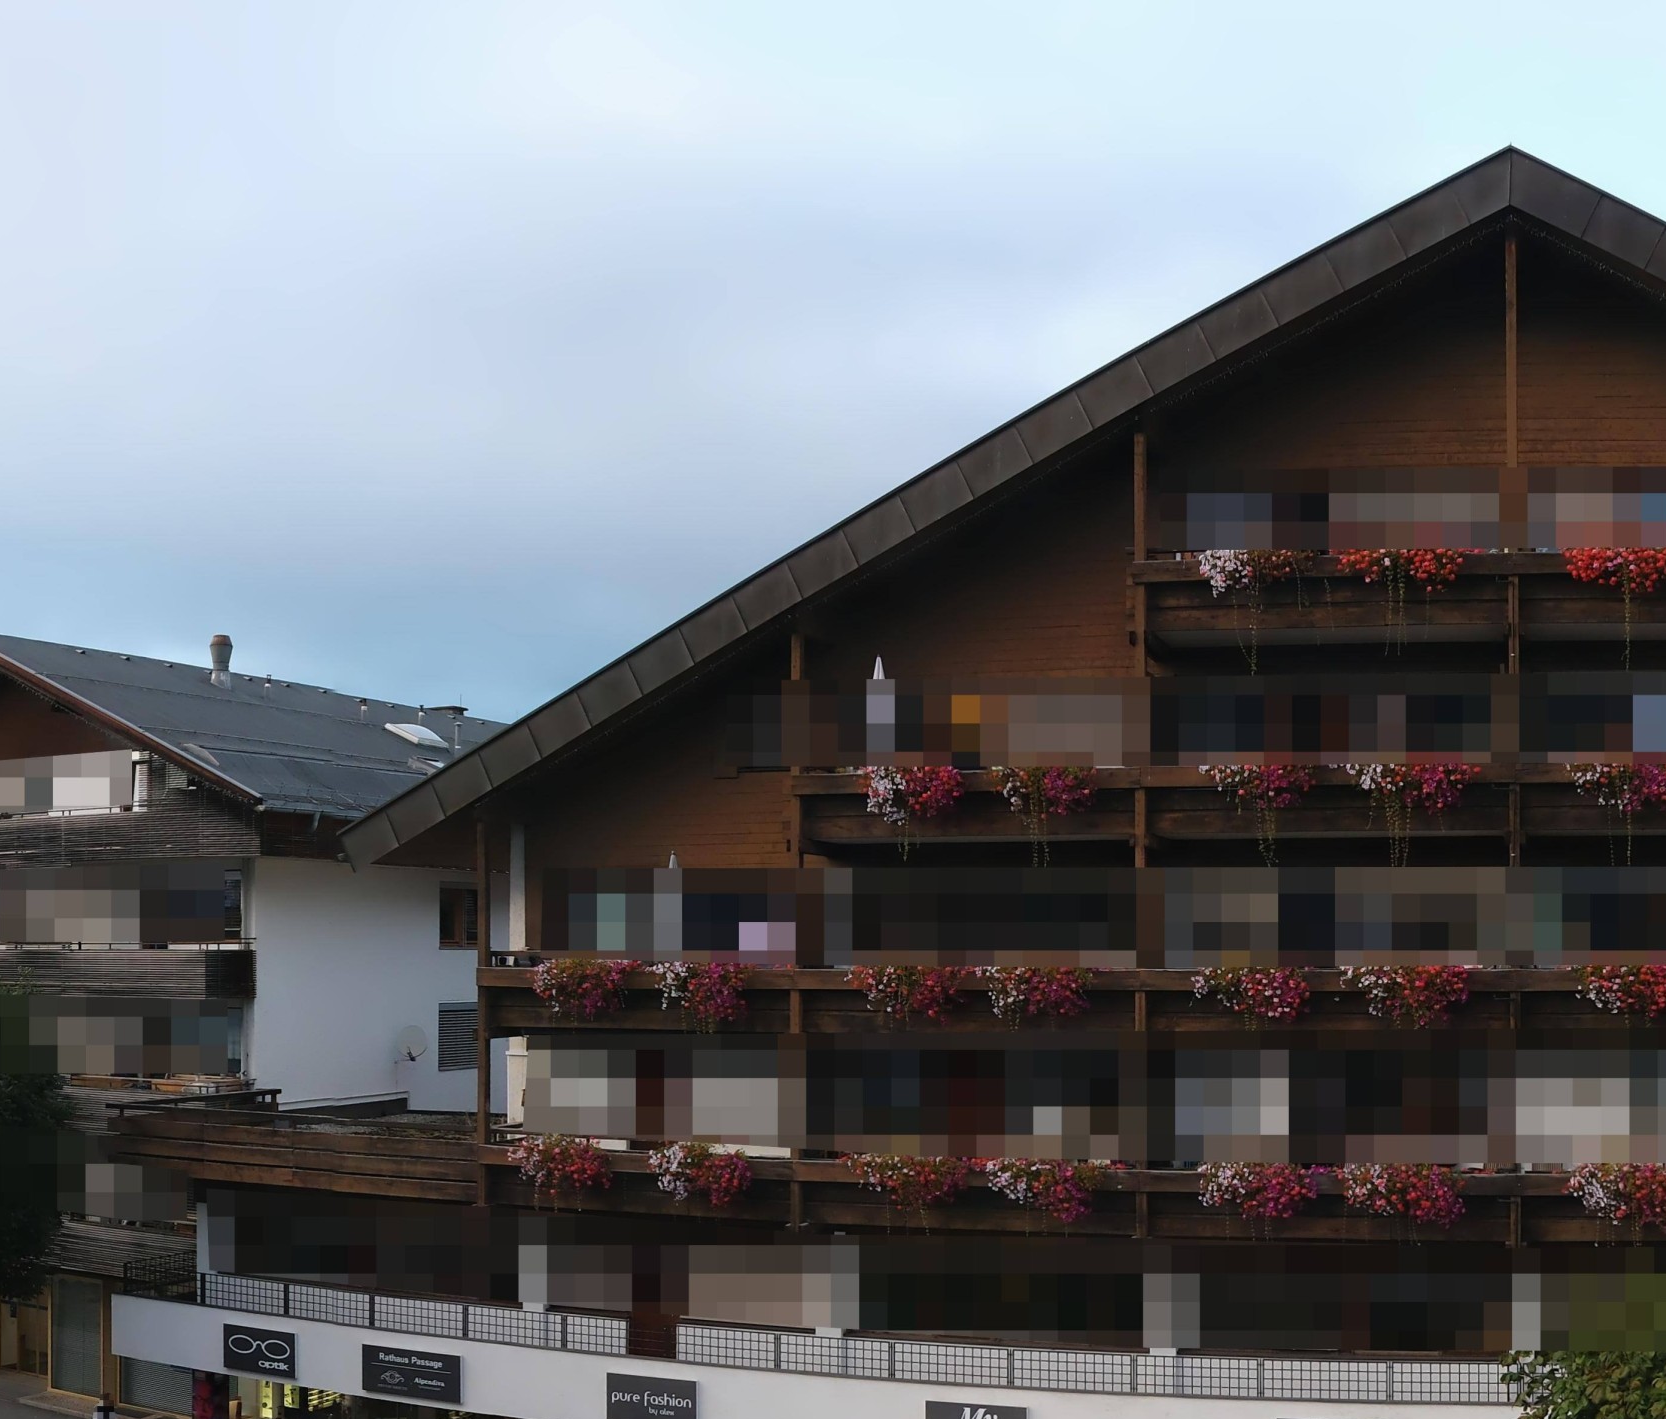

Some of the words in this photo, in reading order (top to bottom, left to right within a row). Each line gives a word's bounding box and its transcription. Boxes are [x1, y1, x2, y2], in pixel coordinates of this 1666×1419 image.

[258, 1360, 290, 1372] optik
[379, 1351, 409, 1365] Rathaus
[411, 1355, 443, 1370] Passage
[611, 1390, 641, 1404] pure
[644, 1390, 692, 1409] fashion
[648, 1406, 659, 1417] by
